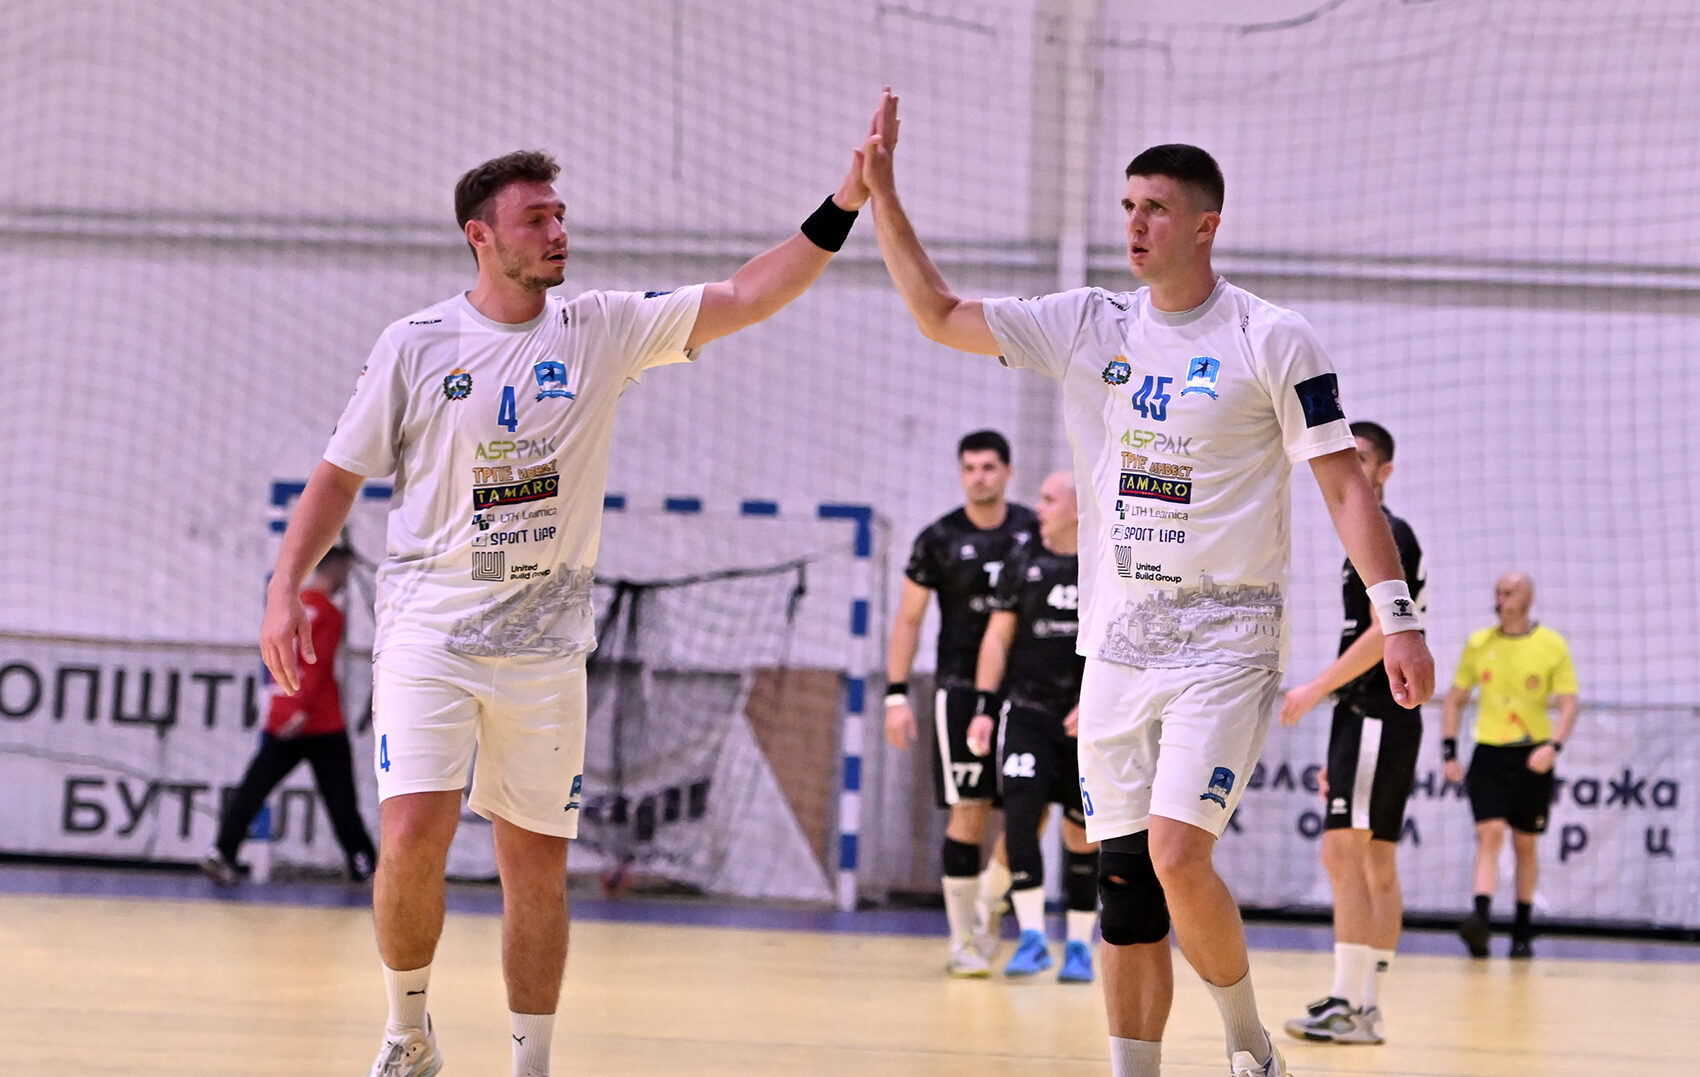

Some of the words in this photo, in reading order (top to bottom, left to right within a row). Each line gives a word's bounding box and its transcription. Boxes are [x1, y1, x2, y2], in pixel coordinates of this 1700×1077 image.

[498, 386, 518, 432] 4
[1131, 375, 1174, 422] 45
[474, 435, 558, 460] ASPPAK
[1120, 428, 1193, 456] ASPPAK
[476, 478, 558, 504] TAMARO
[1121, 474, 1189, 497] TAMARO
[1131, 505, 1148, 517] LTH
[1149, 507, 1189, 521] Learnica
[510, 563, 539, 573] United
[982, 561, 1005, 588] 7
[1135, 562, 1162, 572] United
[1135, 571, 1155, 582] Build
[1154, 573, 1183, 584] Group
[1046, 583, 1078, 610] 42
[380, 733, 391, 773] 4
[1002, 752, 1036, 778] 42
[951, 761, 984, 788] 77
[63, 776, 317, 844] БУТЛ
[1080, 776, 1095, 817] 5
